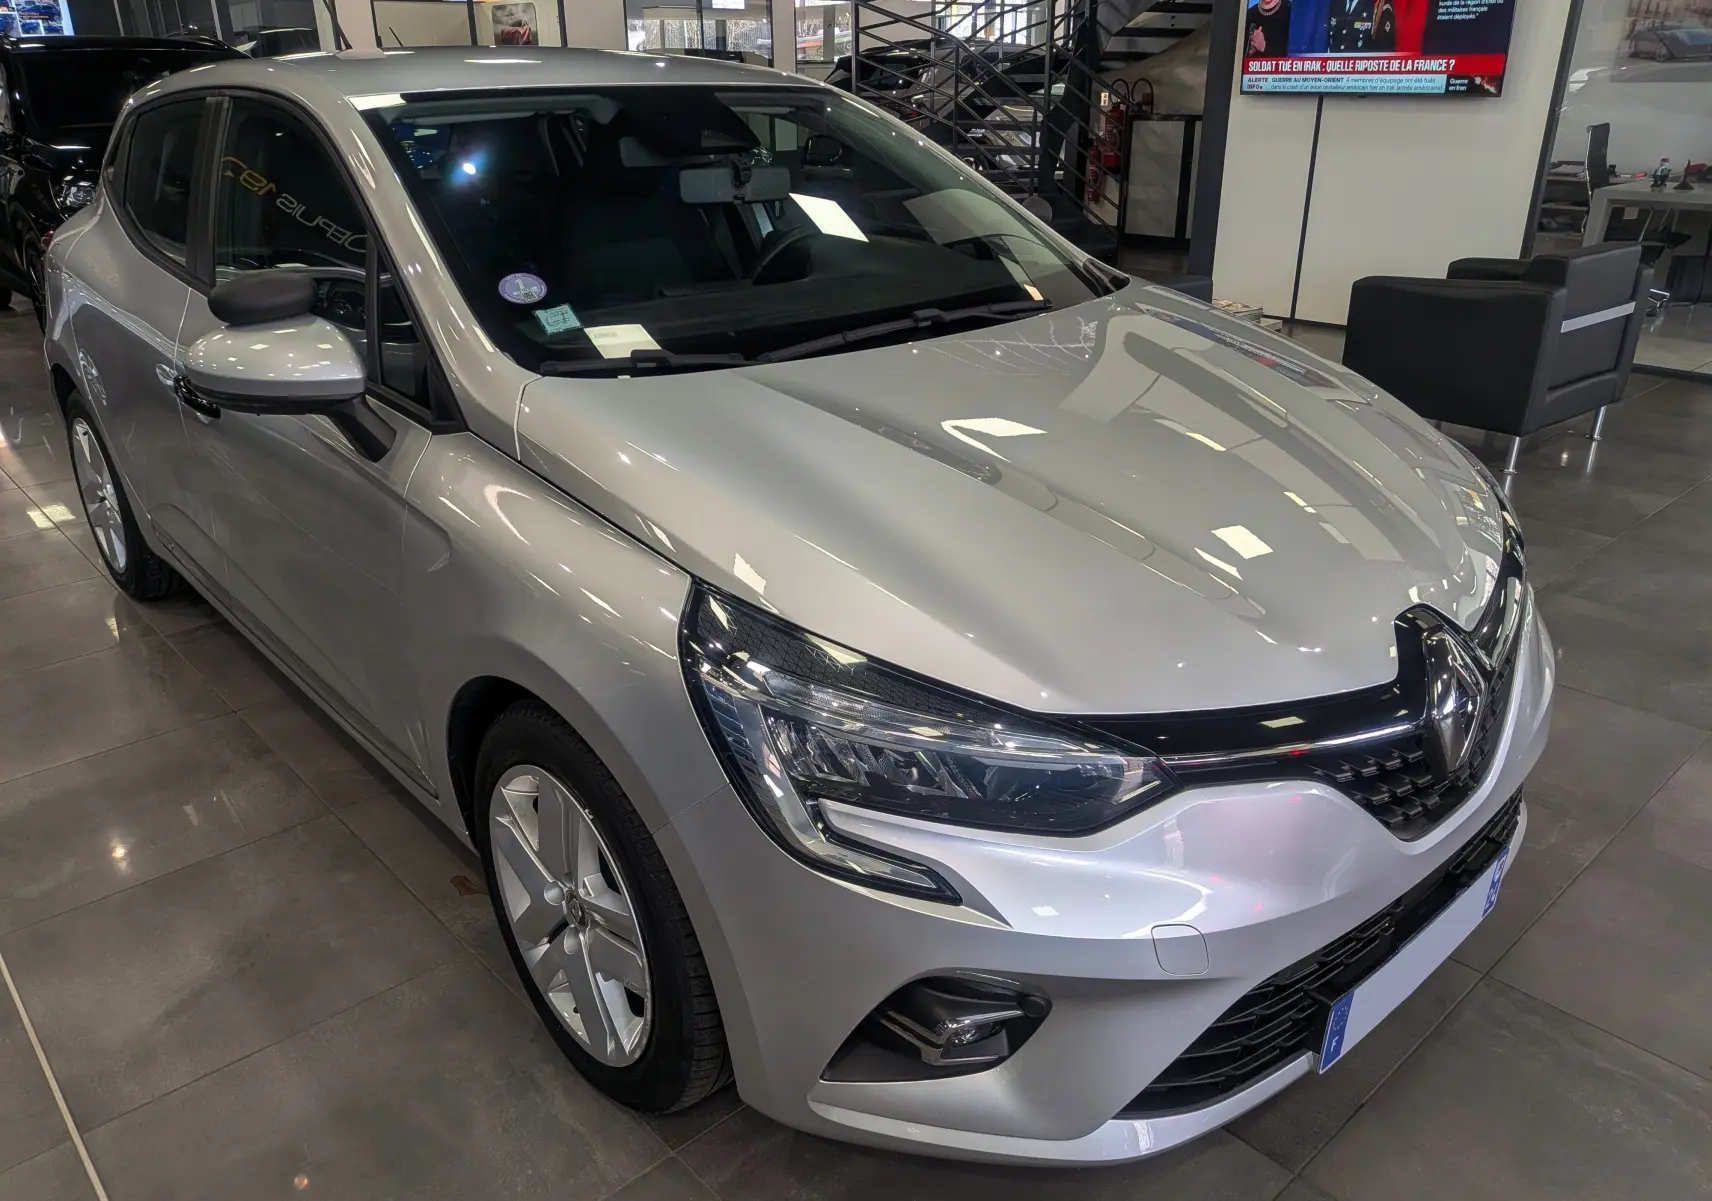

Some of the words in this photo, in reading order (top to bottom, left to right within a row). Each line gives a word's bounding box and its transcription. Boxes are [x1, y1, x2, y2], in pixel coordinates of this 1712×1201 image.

[1248, 61, 1276, 72] SOLDAT
[1278, 59, 1292, 71] TUÉ
[1293, 61, 1302, 71] EN
[1304, 61, 1321, 71] IRAK
[1326, 60, 1354, 72] QUELLE
[1355, 60, 1389, 71] RIPOSTE
[1390, 60, 1400, 71] DE
[1401, 60, 1412, 71] LA
[1414, 60, 1448, 71] FRANCE
[1449, 60, 1456, 71] ?
[1330, 1036, 1339, 1052] F
